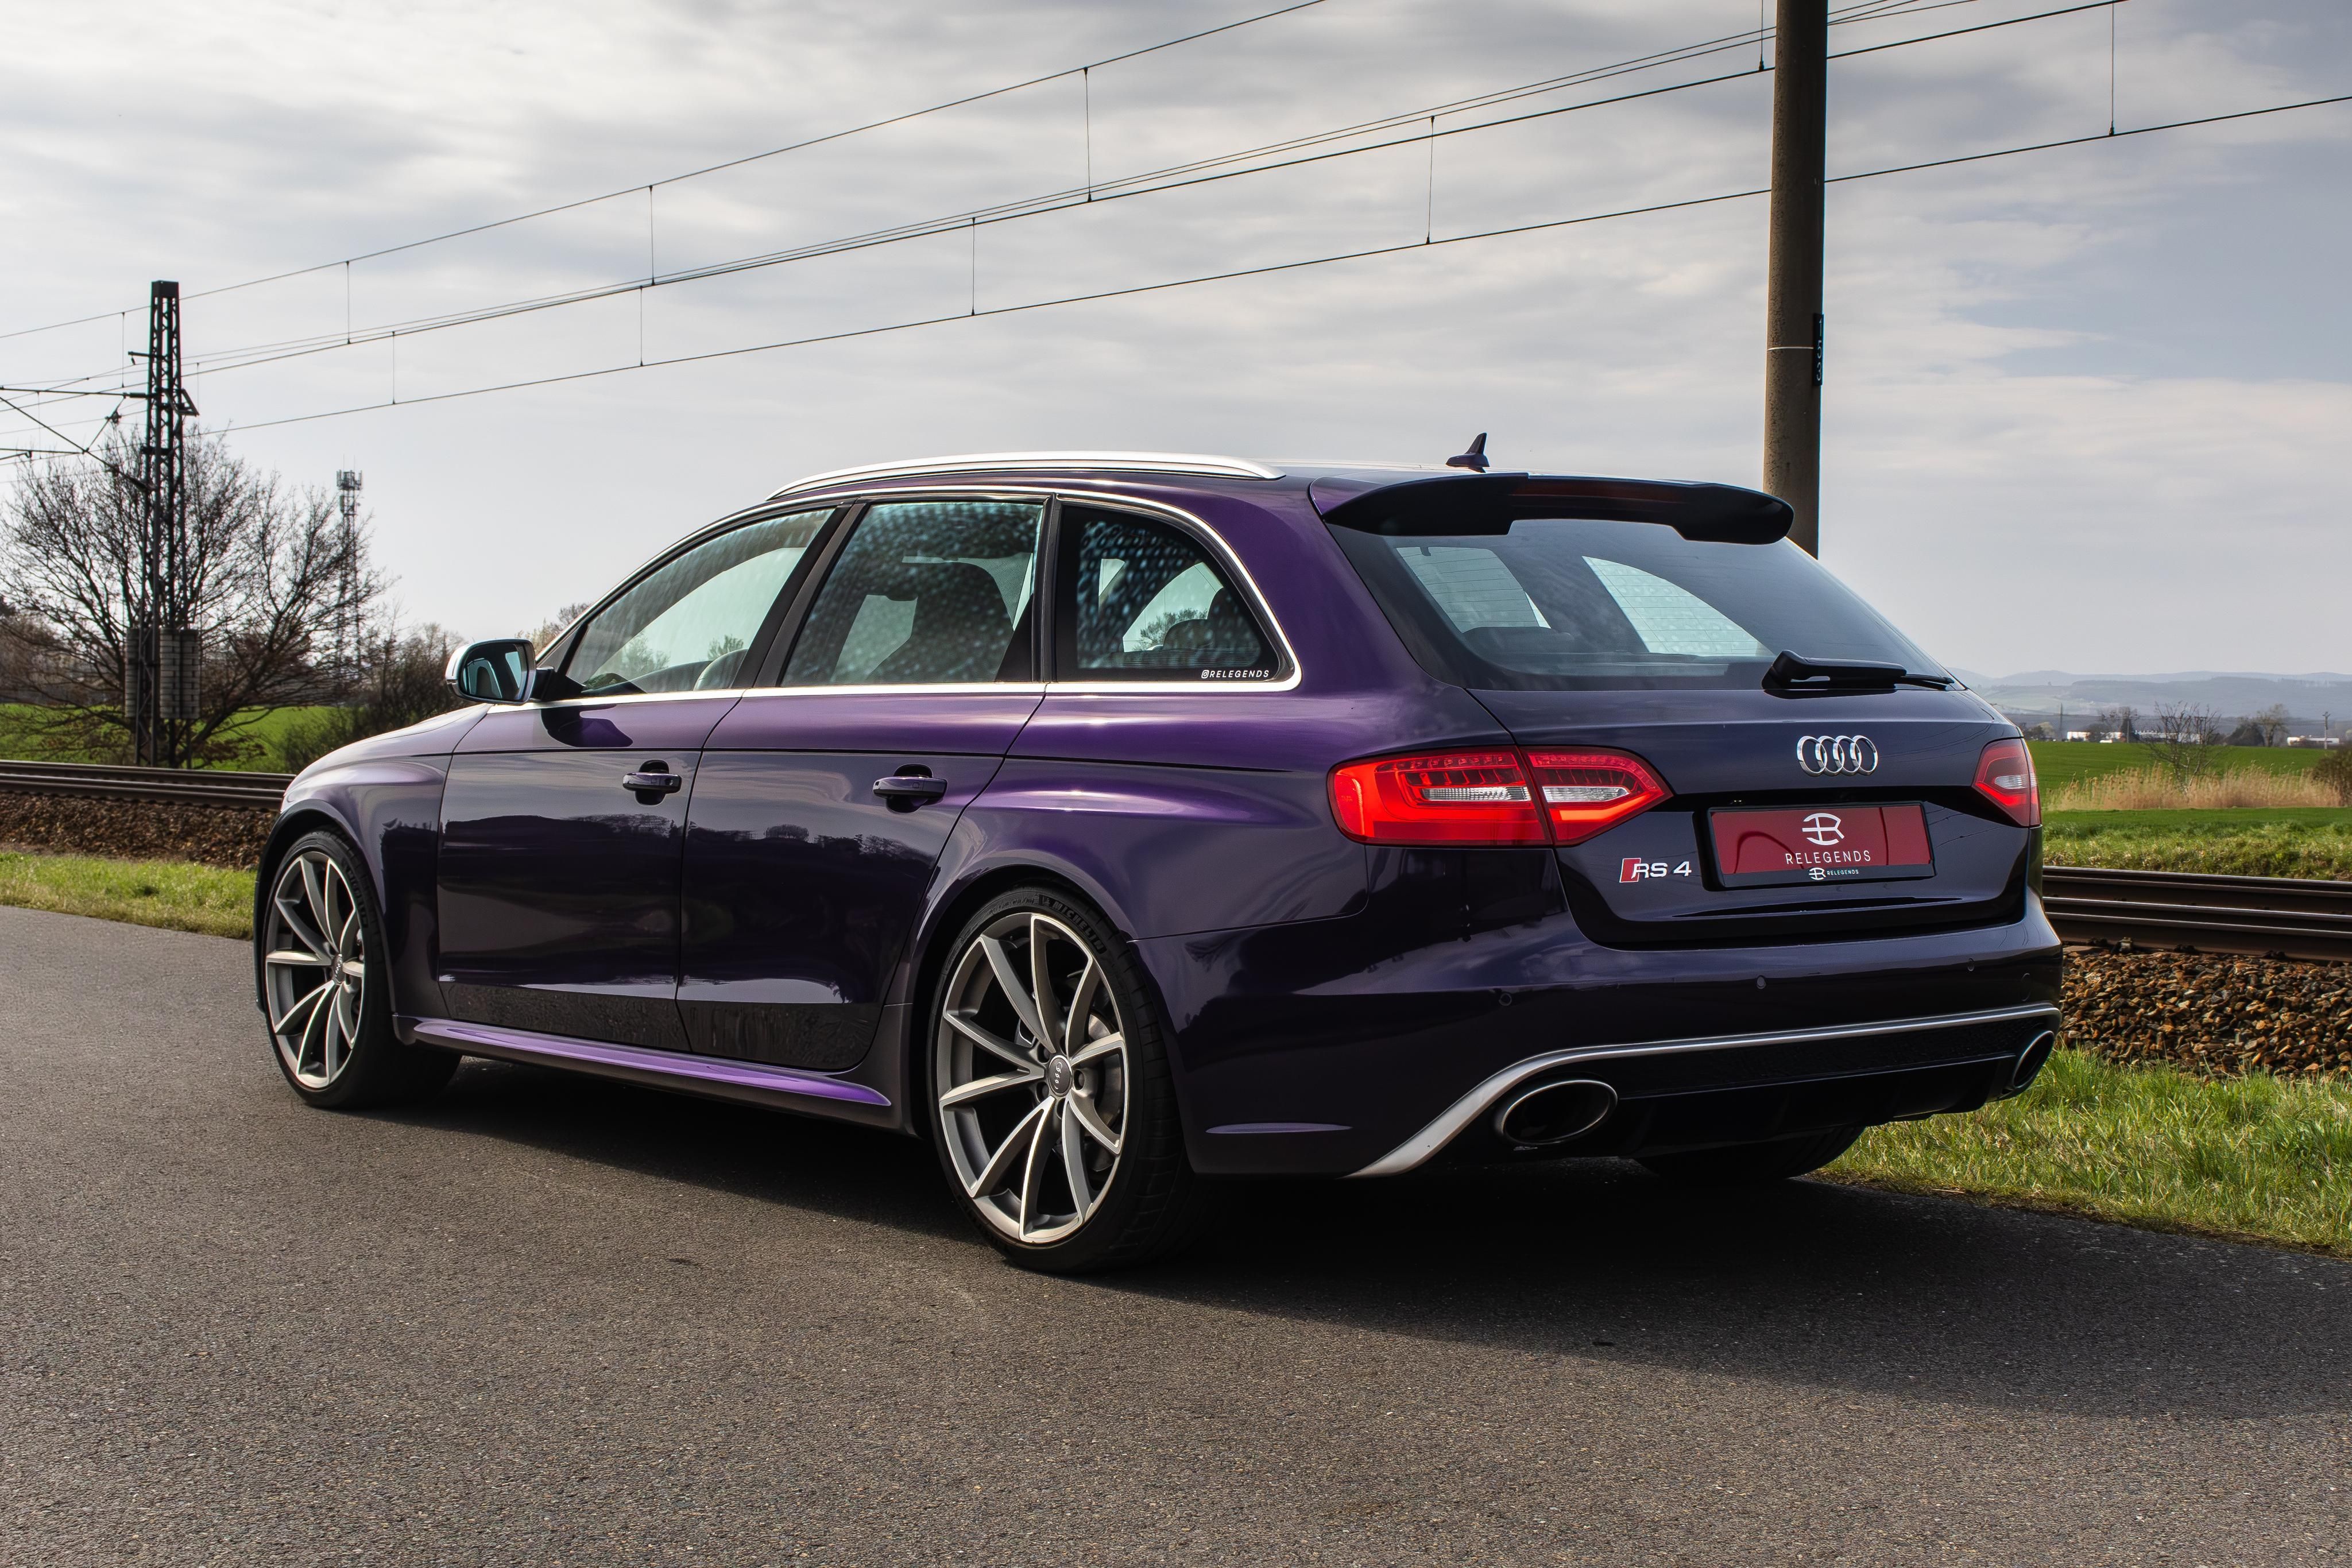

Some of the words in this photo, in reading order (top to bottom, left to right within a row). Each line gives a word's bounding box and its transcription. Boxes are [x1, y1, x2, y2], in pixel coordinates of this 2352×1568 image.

[1785, 850, 1871, 864] RELEGENDS
[1631, 863, 1668, 879] RS
[1673, 861, 1692, 876] 4
[1053, 902, 1104, 951] MICHELIN
